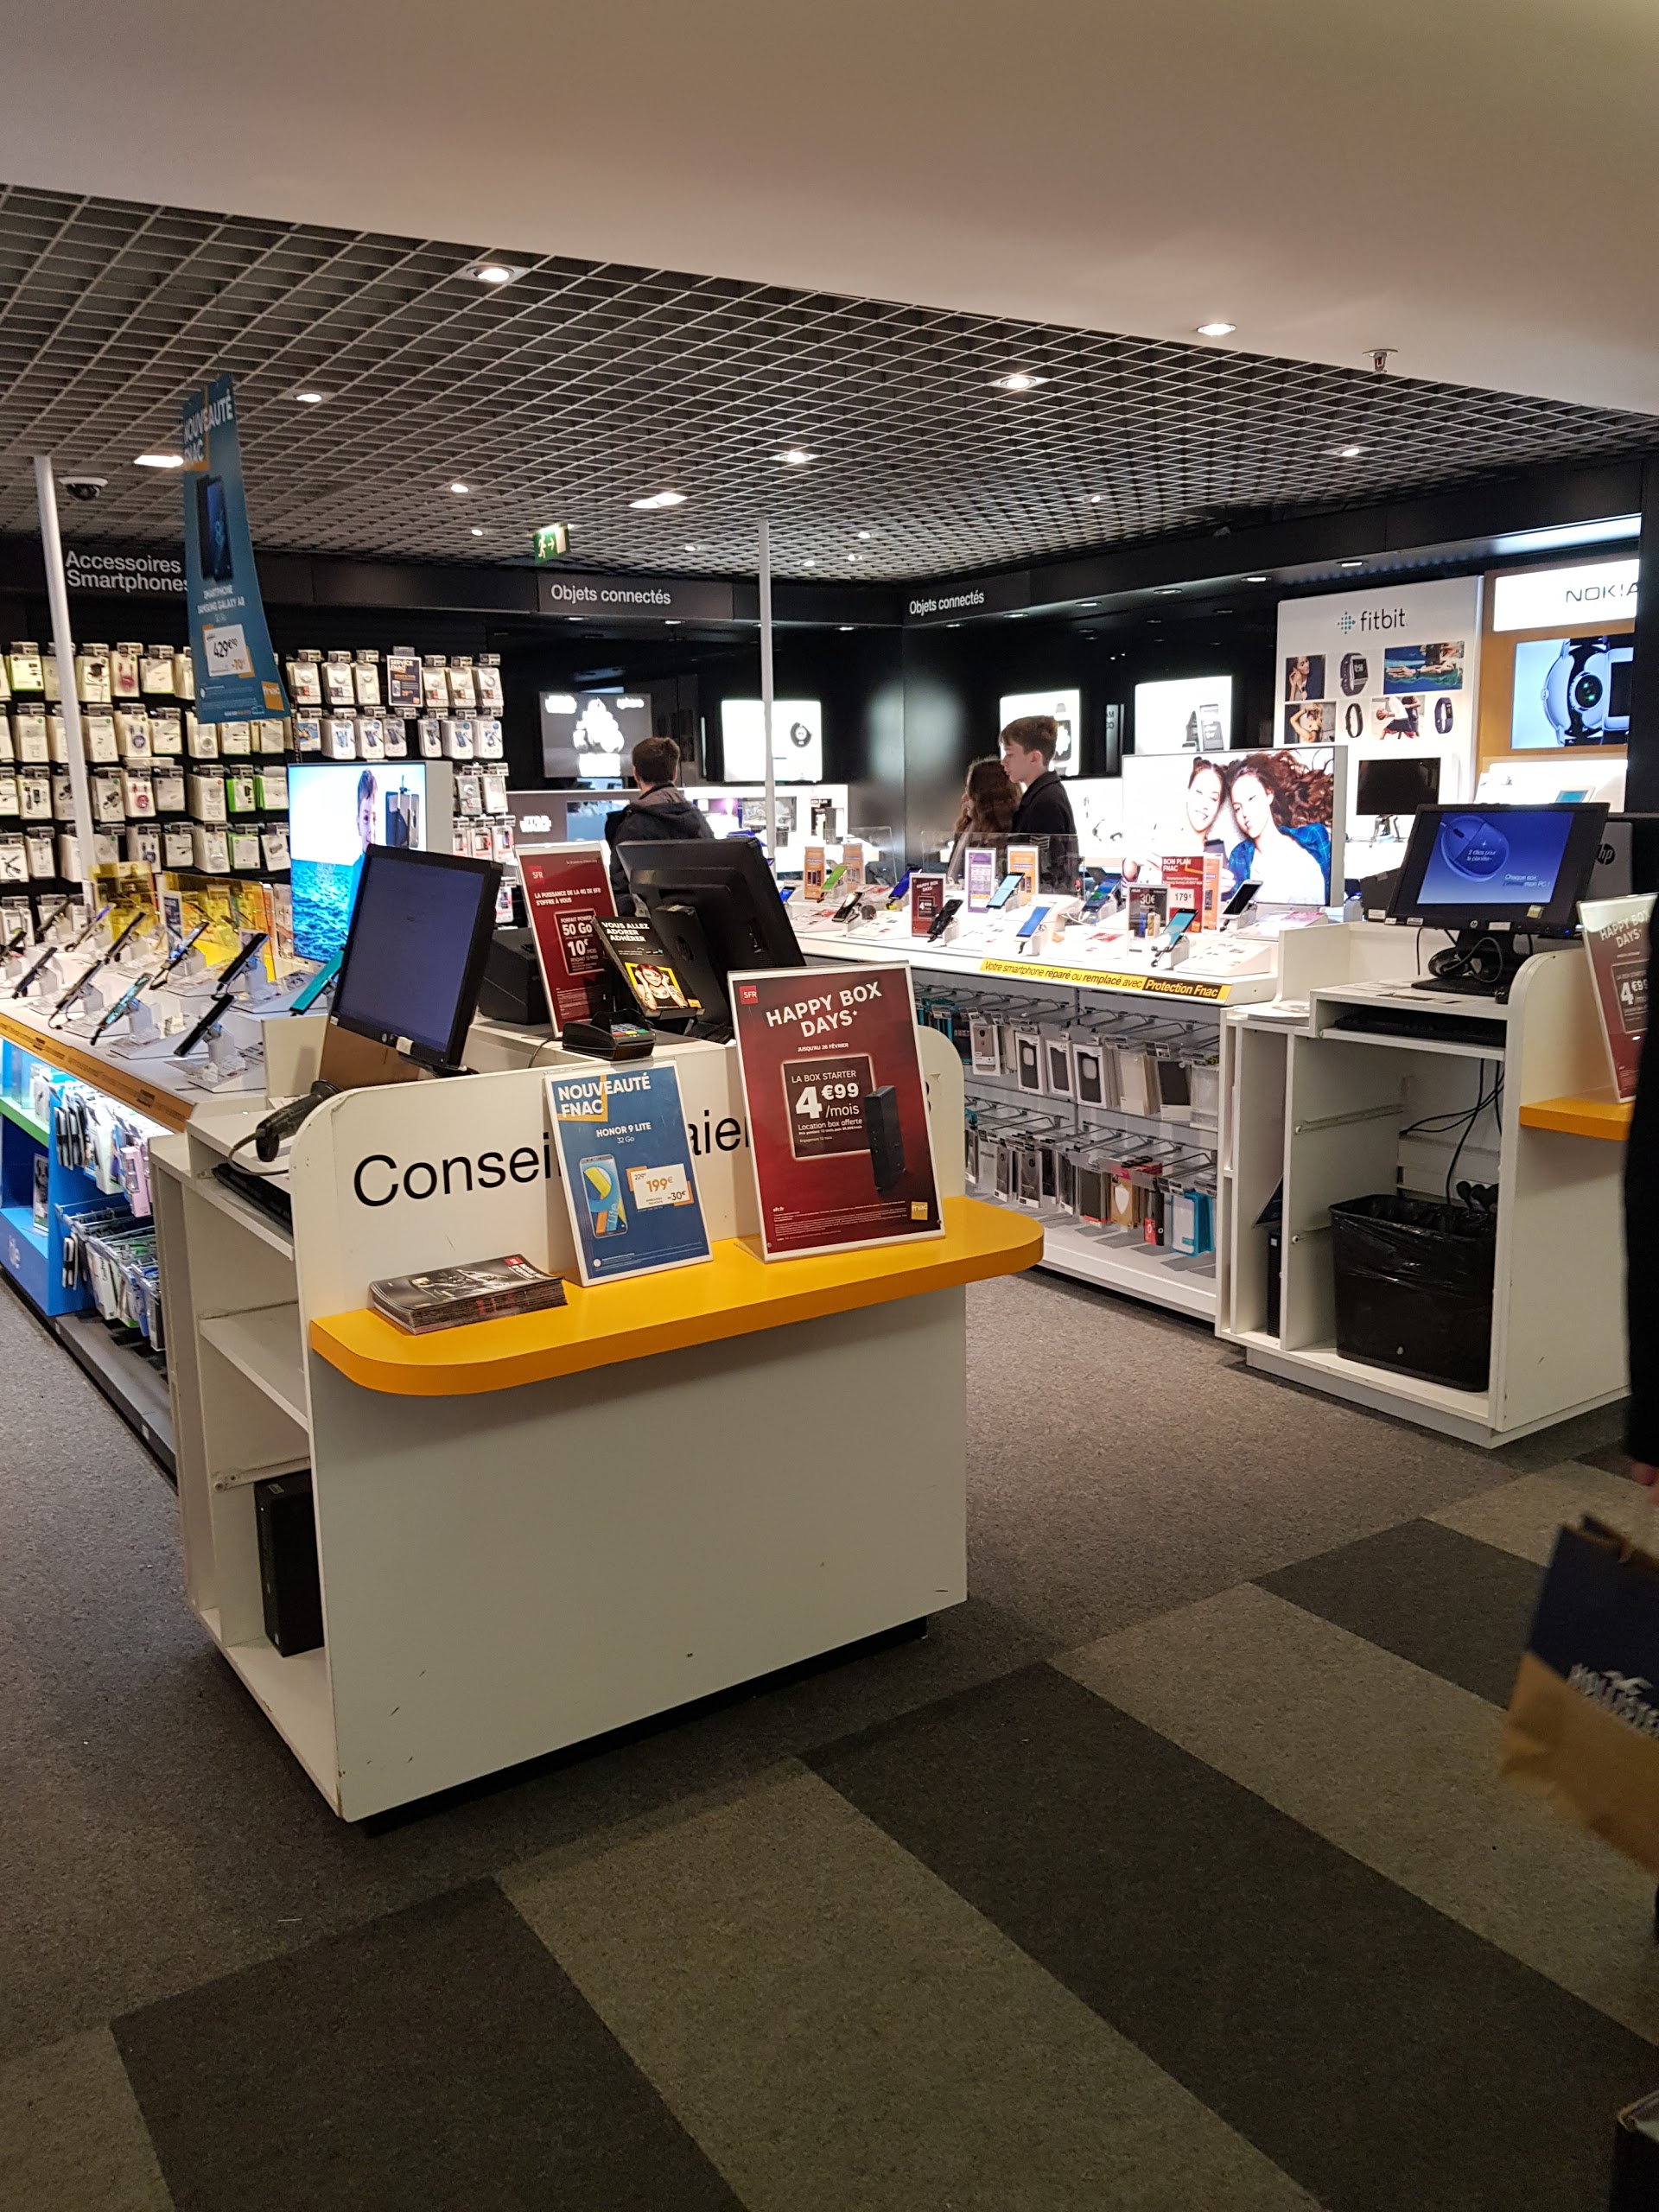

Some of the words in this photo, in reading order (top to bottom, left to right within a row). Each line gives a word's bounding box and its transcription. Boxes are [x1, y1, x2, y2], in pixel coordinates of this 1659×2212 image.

[65, 550, 181, 574] Accessoires
[551, 584, 597, 604] Objets
[601, 589, 671, 605] connectés
[909, 599, 937, 616] Objets
[938, 589, 985, 610] connectés
[1360, 608, 1407, 631] fitbit
[532, 871, 543, 880] SFR
[541, 890, 567, 899] PUISSANCE
[1140, 893, 1155, 905] 30€
[562, 924, 576, 937] 50
[577, 922, 593, 934] Go
[1599, 918, 1630, 941] HAPPY
[567, 938, 589, 957] 10€
[985, 960, 1002, 971] Votre
[1002, 963, 1045, 976] smartphone
[1045, 969, 1071, 980] réparé
[1083, 974, 1122, 986] remplacé
[1122, 978, 1143, 988] avec
[1145, 979, 1192, 995] Protection
[1193, 984, 1219, 997] Fnac
[766, 995, 832, 1027] HAPPY
[839, 981, 883, 1007] BOX
[791, 1075, 803, 1084] LA
[804, 1073, 821, 1082] BOX
[823, 1070, 857, 1081] STARTER
[558, 1072, 652, 1102] NOUVEAUTÉ
[560, 1099, 604, 1119] FNAC
[825, 1103, 860, 1118] /mois
[595, 1125, 627, 1138] HONOR
[627, 1124, 634, 1133] 9
[634, 1122, 652, 1132] LITE
[798, 1122, 827, 1131] Location
[841, 1118, 863, 1127] offerte
[353, 1132, 561, 1206] Consei
[646, 1176, 674, 1193] 199€
[667, 1190, 688, 1201] -30€
